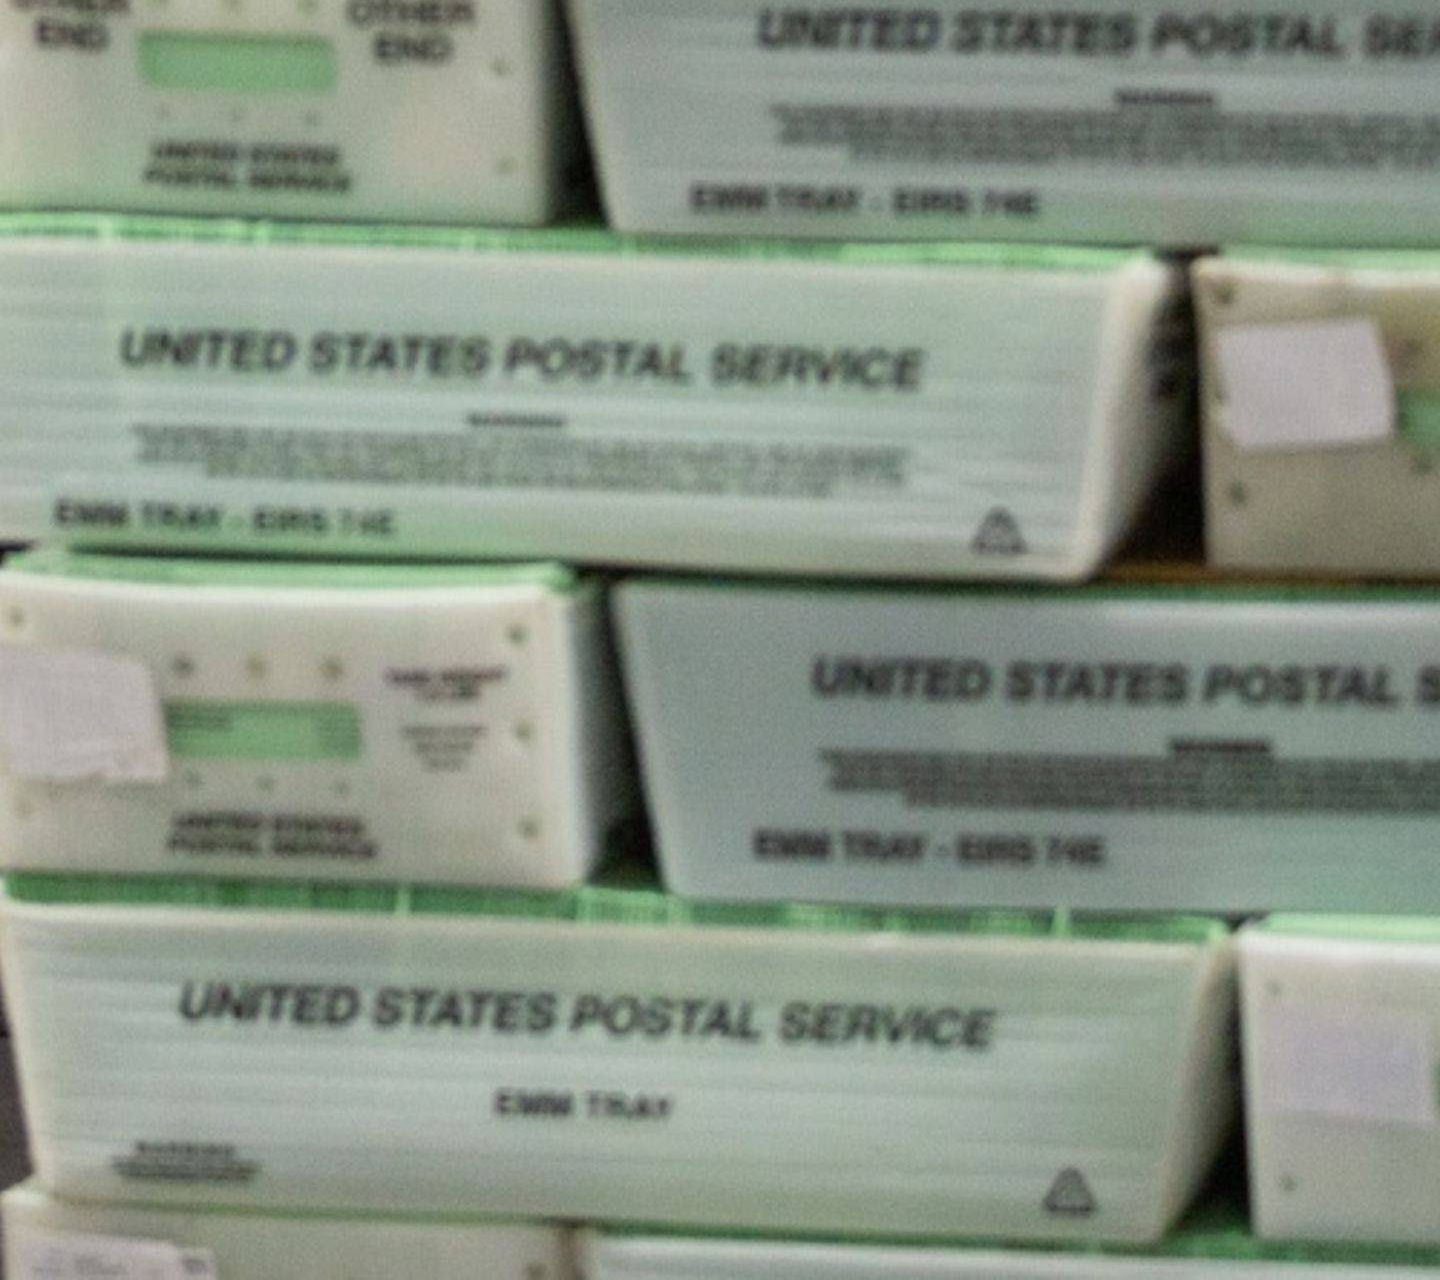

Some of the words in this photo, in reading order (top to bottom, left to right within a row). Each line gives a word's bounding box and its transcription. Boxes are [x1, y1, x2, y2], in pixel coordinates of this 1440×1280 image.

[34, 18, 109, 52] END
[372, 34, 454, 65] END
[758, 8, 942, 54] UNITED
[952, 11, 1136, 58] STATES
[1149, 12, 1353, 60] POSTAL
[120, 329, 295, 375] UNITED
[308, 333, 489, 380] STATES
[505, 339, 689, 385] POSTAL
[713, 344, 925, 392] SERVICE
[812, 658, 992, 703] UNITED
[1004, 660, 1189, 705] STATES
[1201, 665, 1402, 709] POSTAL
[178, 981, 360, 1031] UNITED
[371, 987, 558, 1036] STATES
[570, 993, 762, 1043] POSTAL
[780, 1002, 996, 1051] SERVICE
[494, 1087, 574, 1119] EMM
[584, 1089, 674, 1124] TRAY
